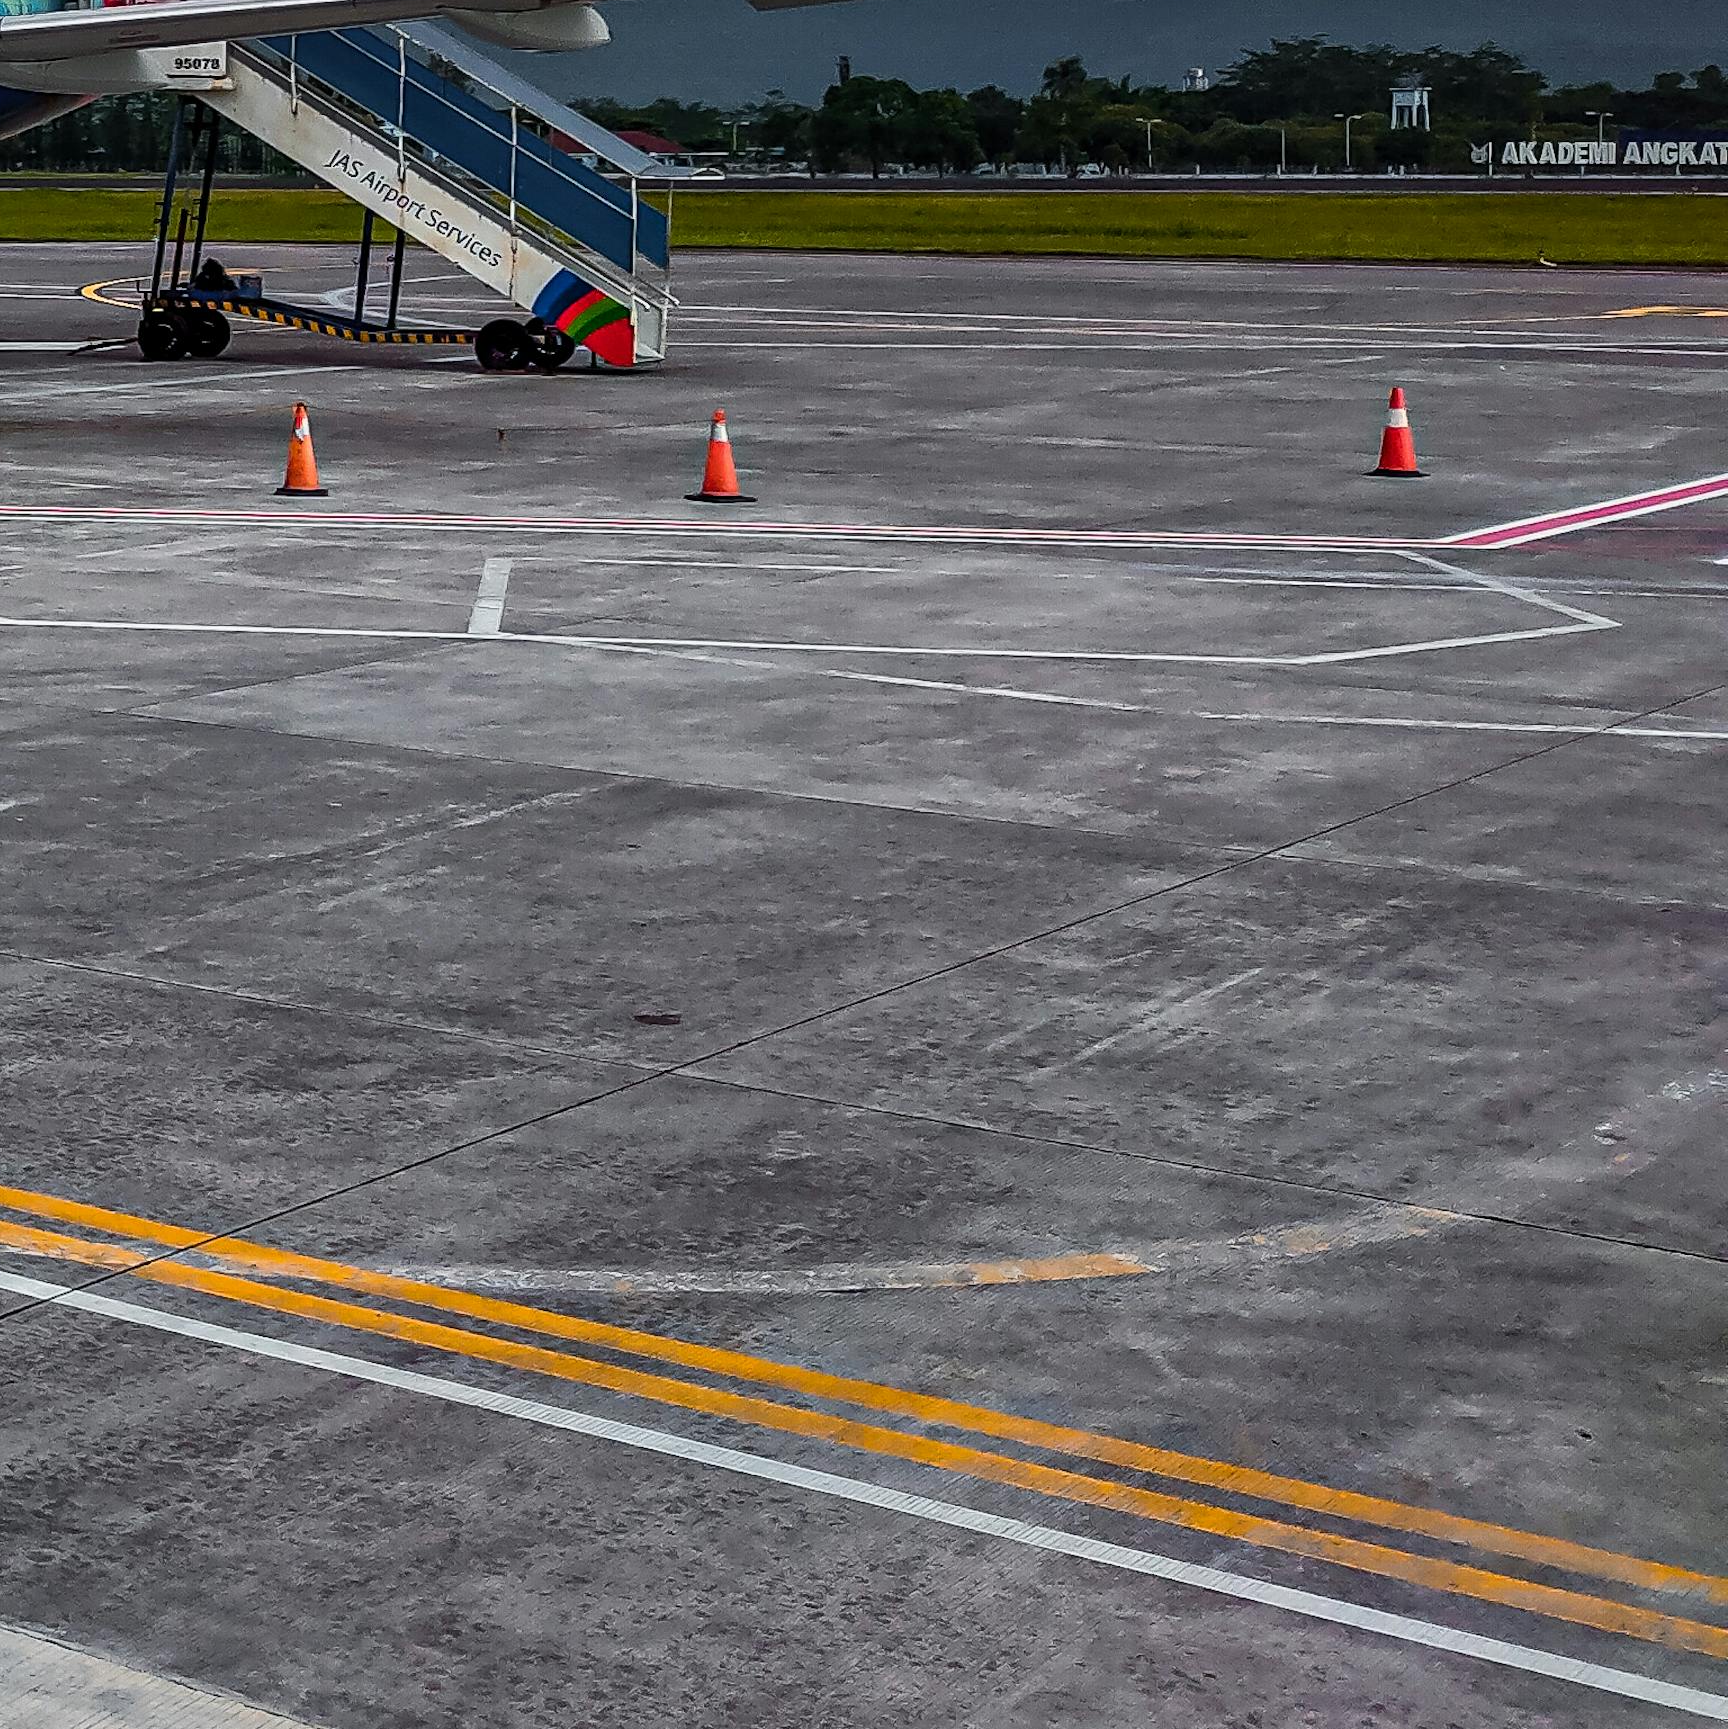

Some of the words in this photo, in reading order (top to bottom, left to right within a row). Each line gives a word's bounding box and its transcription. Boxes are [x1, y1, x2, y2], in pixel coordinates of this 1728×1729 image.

[174, 57, 221, 70] 95078
[1500, 141, 1617, 165] AKADEMI
[323, 149, 364, 177] JAS
[359, 171, 426, 219] Airport
[424, 209, 503, 267] Services
